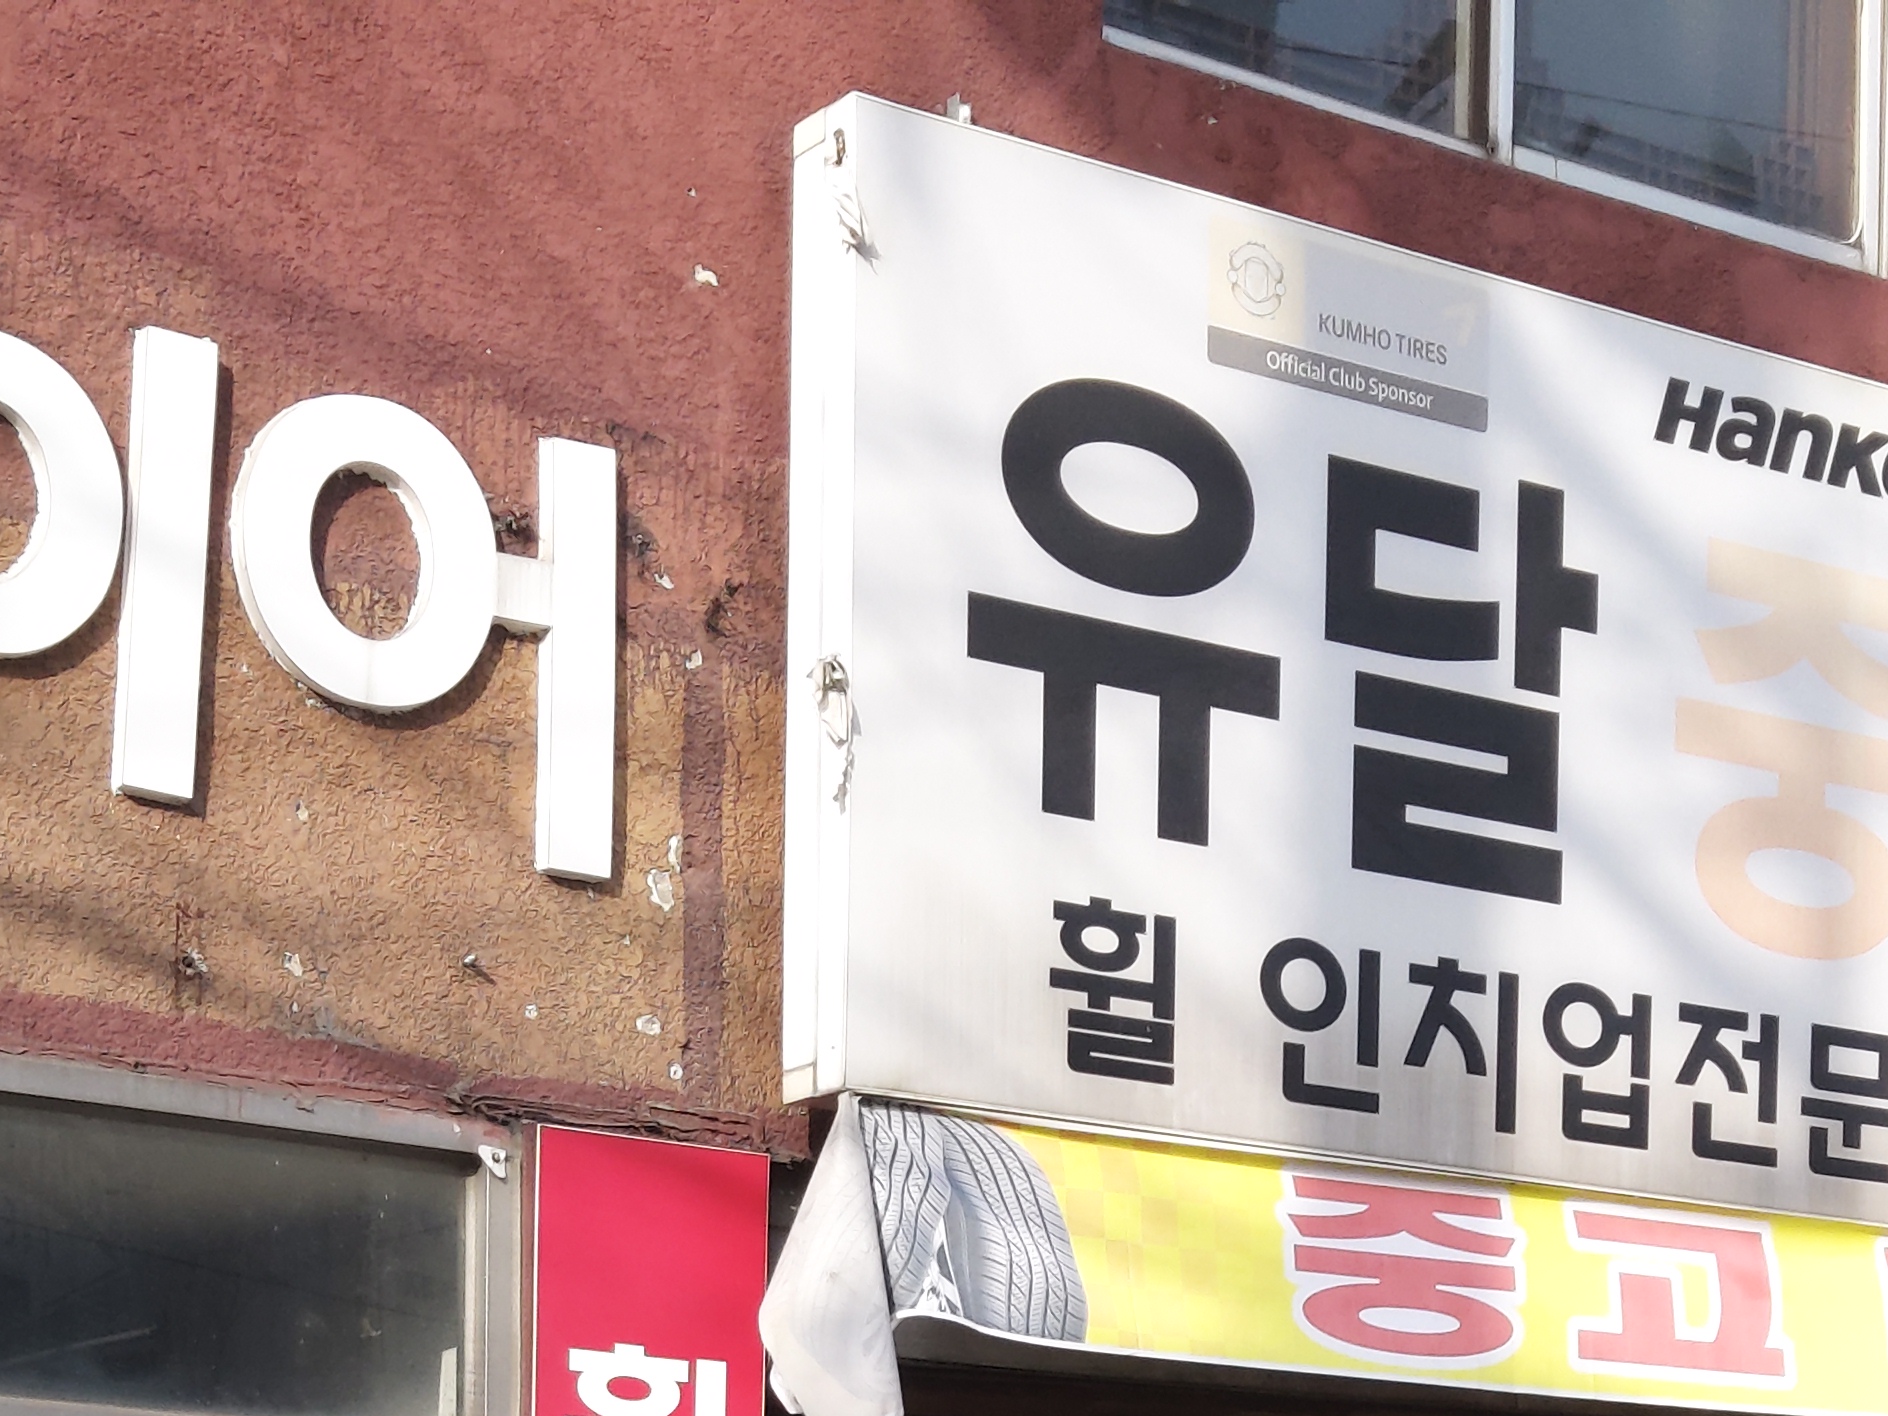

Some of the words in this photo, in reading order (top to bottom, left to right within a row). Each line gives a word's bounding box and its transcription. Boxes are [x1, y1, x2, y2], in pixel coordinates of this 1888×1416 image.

[1266, 351, 1326, 379] Official
[1329, 363, 1366, 394] Club
[1368, 374, 1435, 413] Sponsor
[1317, 312, 1392, 351] KUMHO
[1396, 331, 1449, 367] TIRES
[968, 378, 1598, 903] 유달
[1048, 895, 1176, 1085] 휠
[1290, 1171, 1785, 1378] 중고
